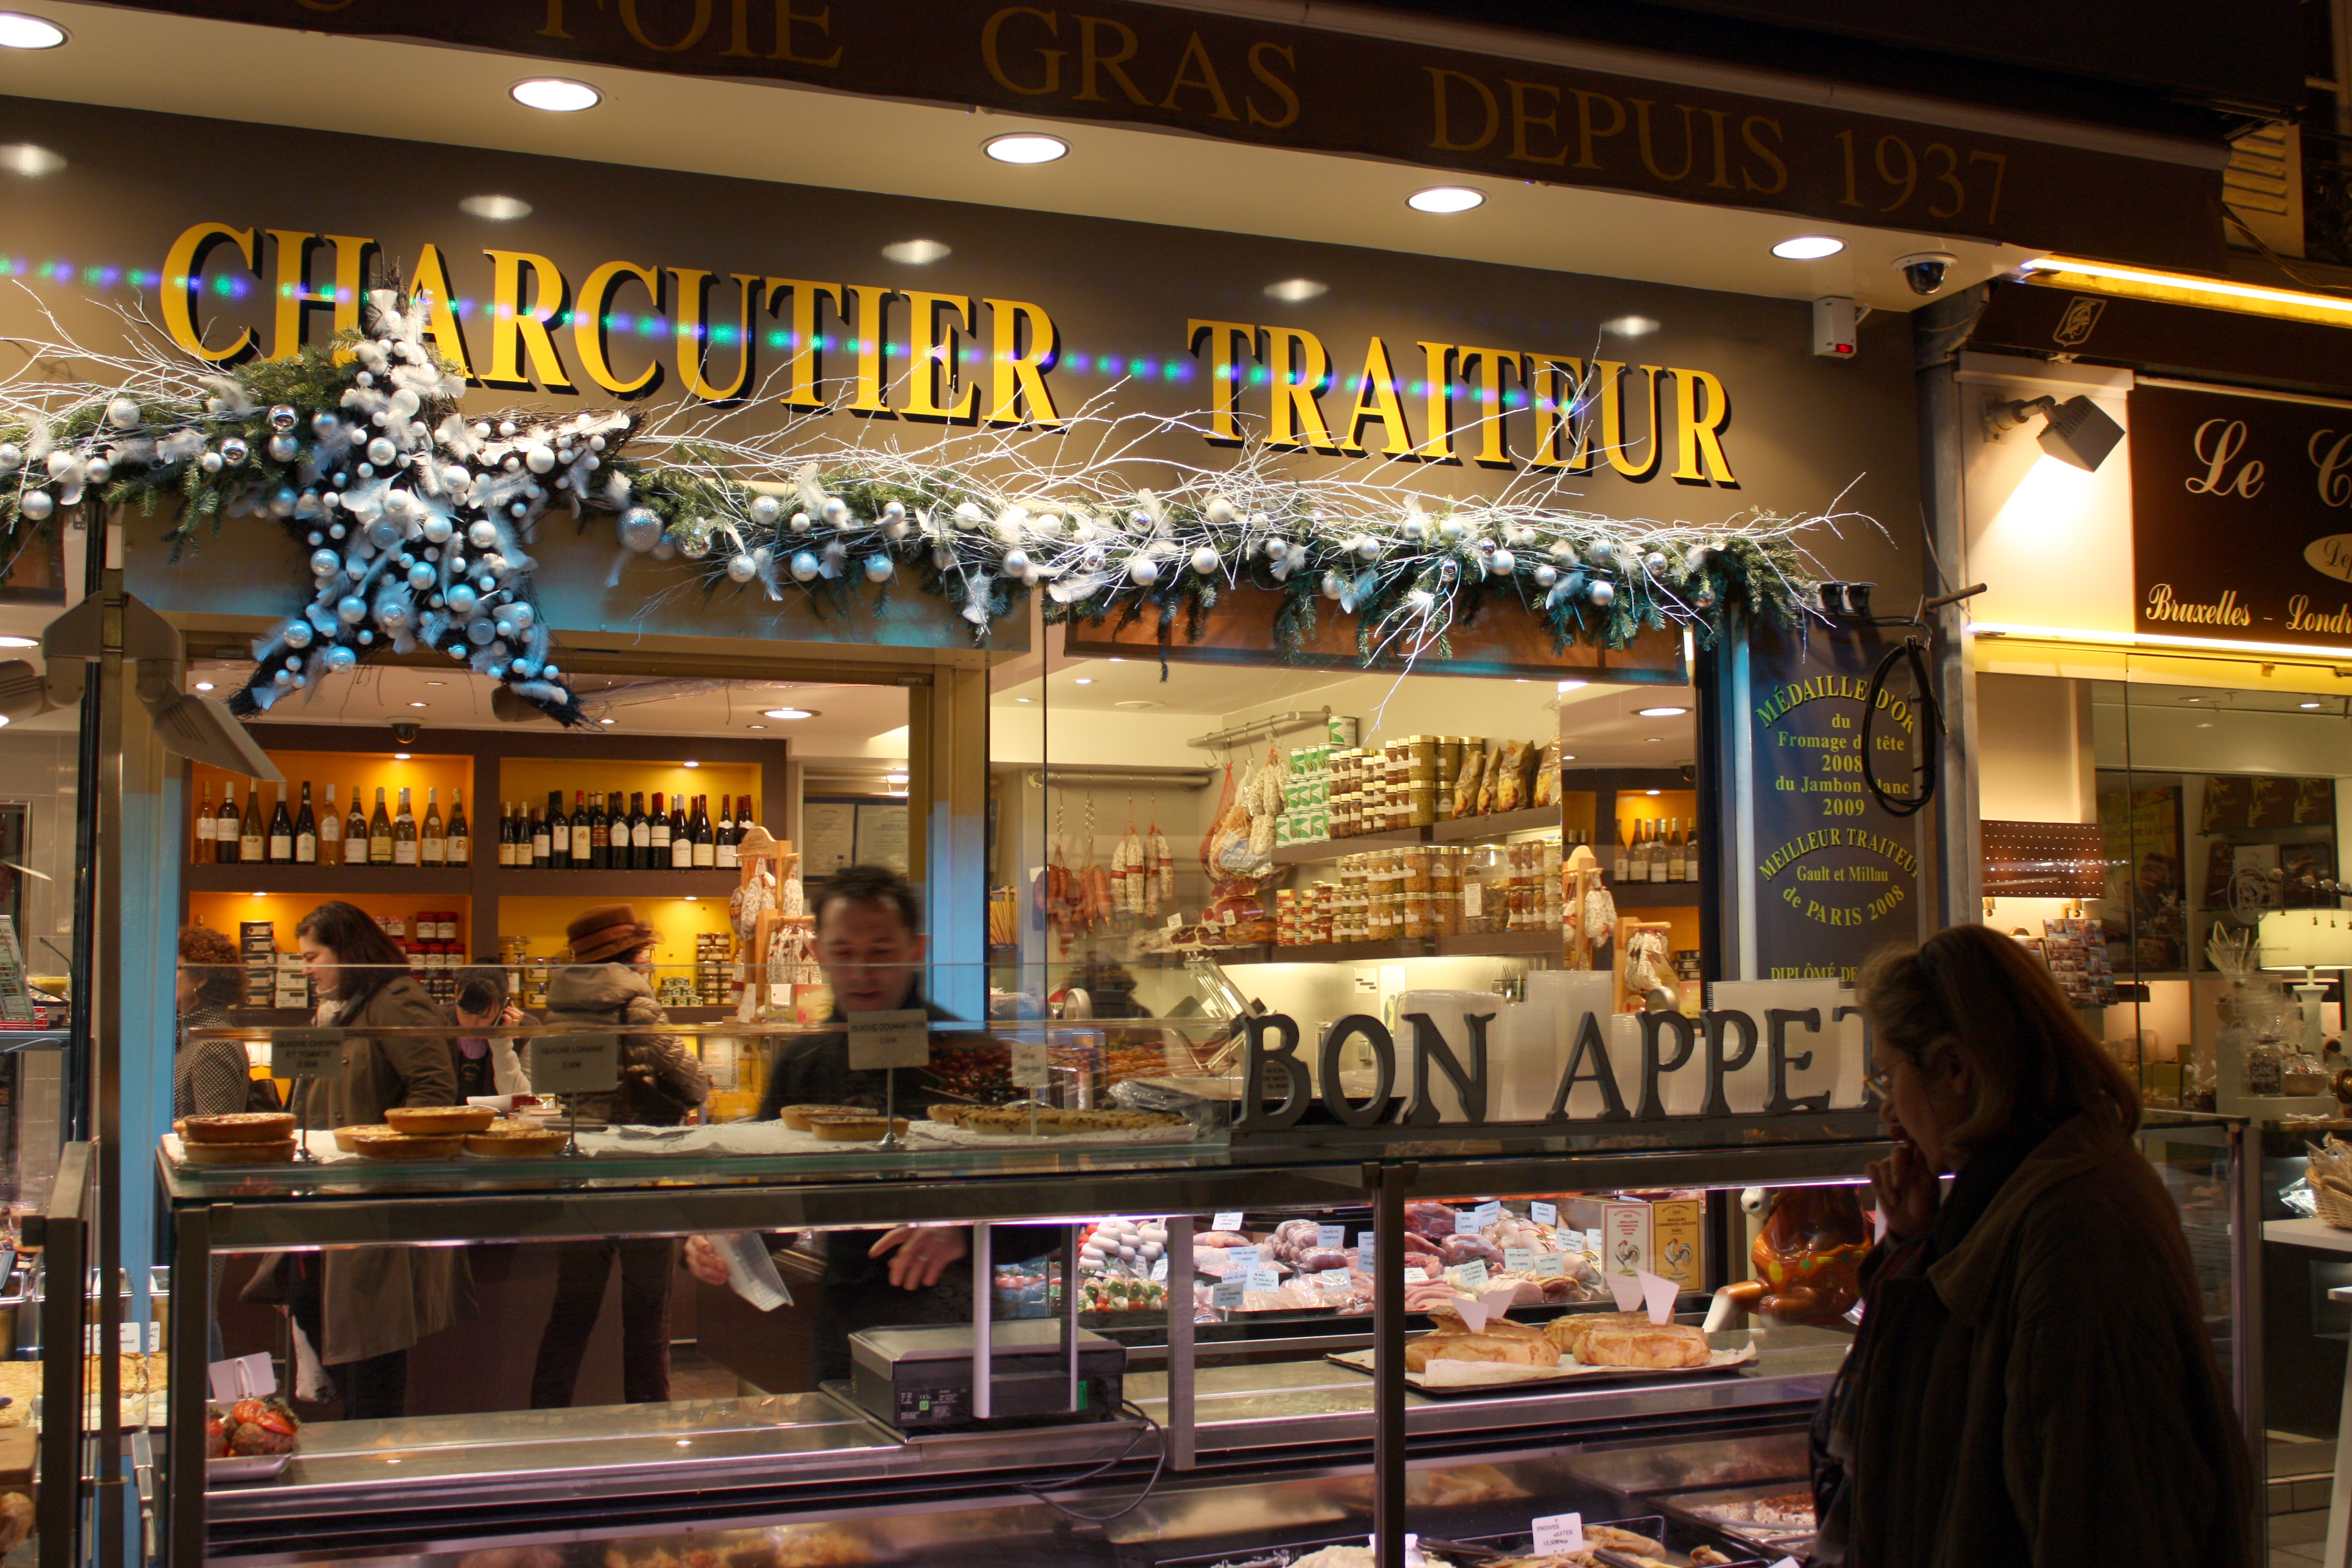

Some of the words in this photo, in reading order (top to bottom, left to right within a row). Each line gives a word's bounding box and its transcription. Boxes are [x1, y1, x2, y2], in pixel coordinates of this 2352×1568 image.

[981, 6, 1300, 128] GRAS
[1423, 66, 1789, 195] DEPUIS
[1833, 129, 2007, 225] 1937
[160, 221, 1066, 433] CHARCUTIER
[1187, 318, 1740, 489] TRAITEUR
[2185, 419, 2264, 498] Le
[2146, 584, 2250, 626] Bruxelles
[1755, 676, 1868, 728] MÉDAILLE
[1832, 714, 1850, 728] du
[1778, 731, 1847, 752] Fromage
[1876, 736, 1904, 750] tête
[1822, 755, 1863, 772] 2008
[1776, 776, 1794, 791] du
[1801, 777, 1861, 793] Jambon
[1869, 779, 1909, 794] lanc
[1823, 799, 1865, 815] 2009
[1758, 828, 1842, 882] MEILLEUR
[1796, 865, 1830, 881] Gault
[1834, 868, 1844, 881] et
[1849, 867, 1888, 881] Millau
[1783, 887, 1801, 907] de
[1806, 900, 1862, 925] PARIS
[1868, 885, 1904, 921] 2008
[1233, 1012, 1496, 1129] BON
